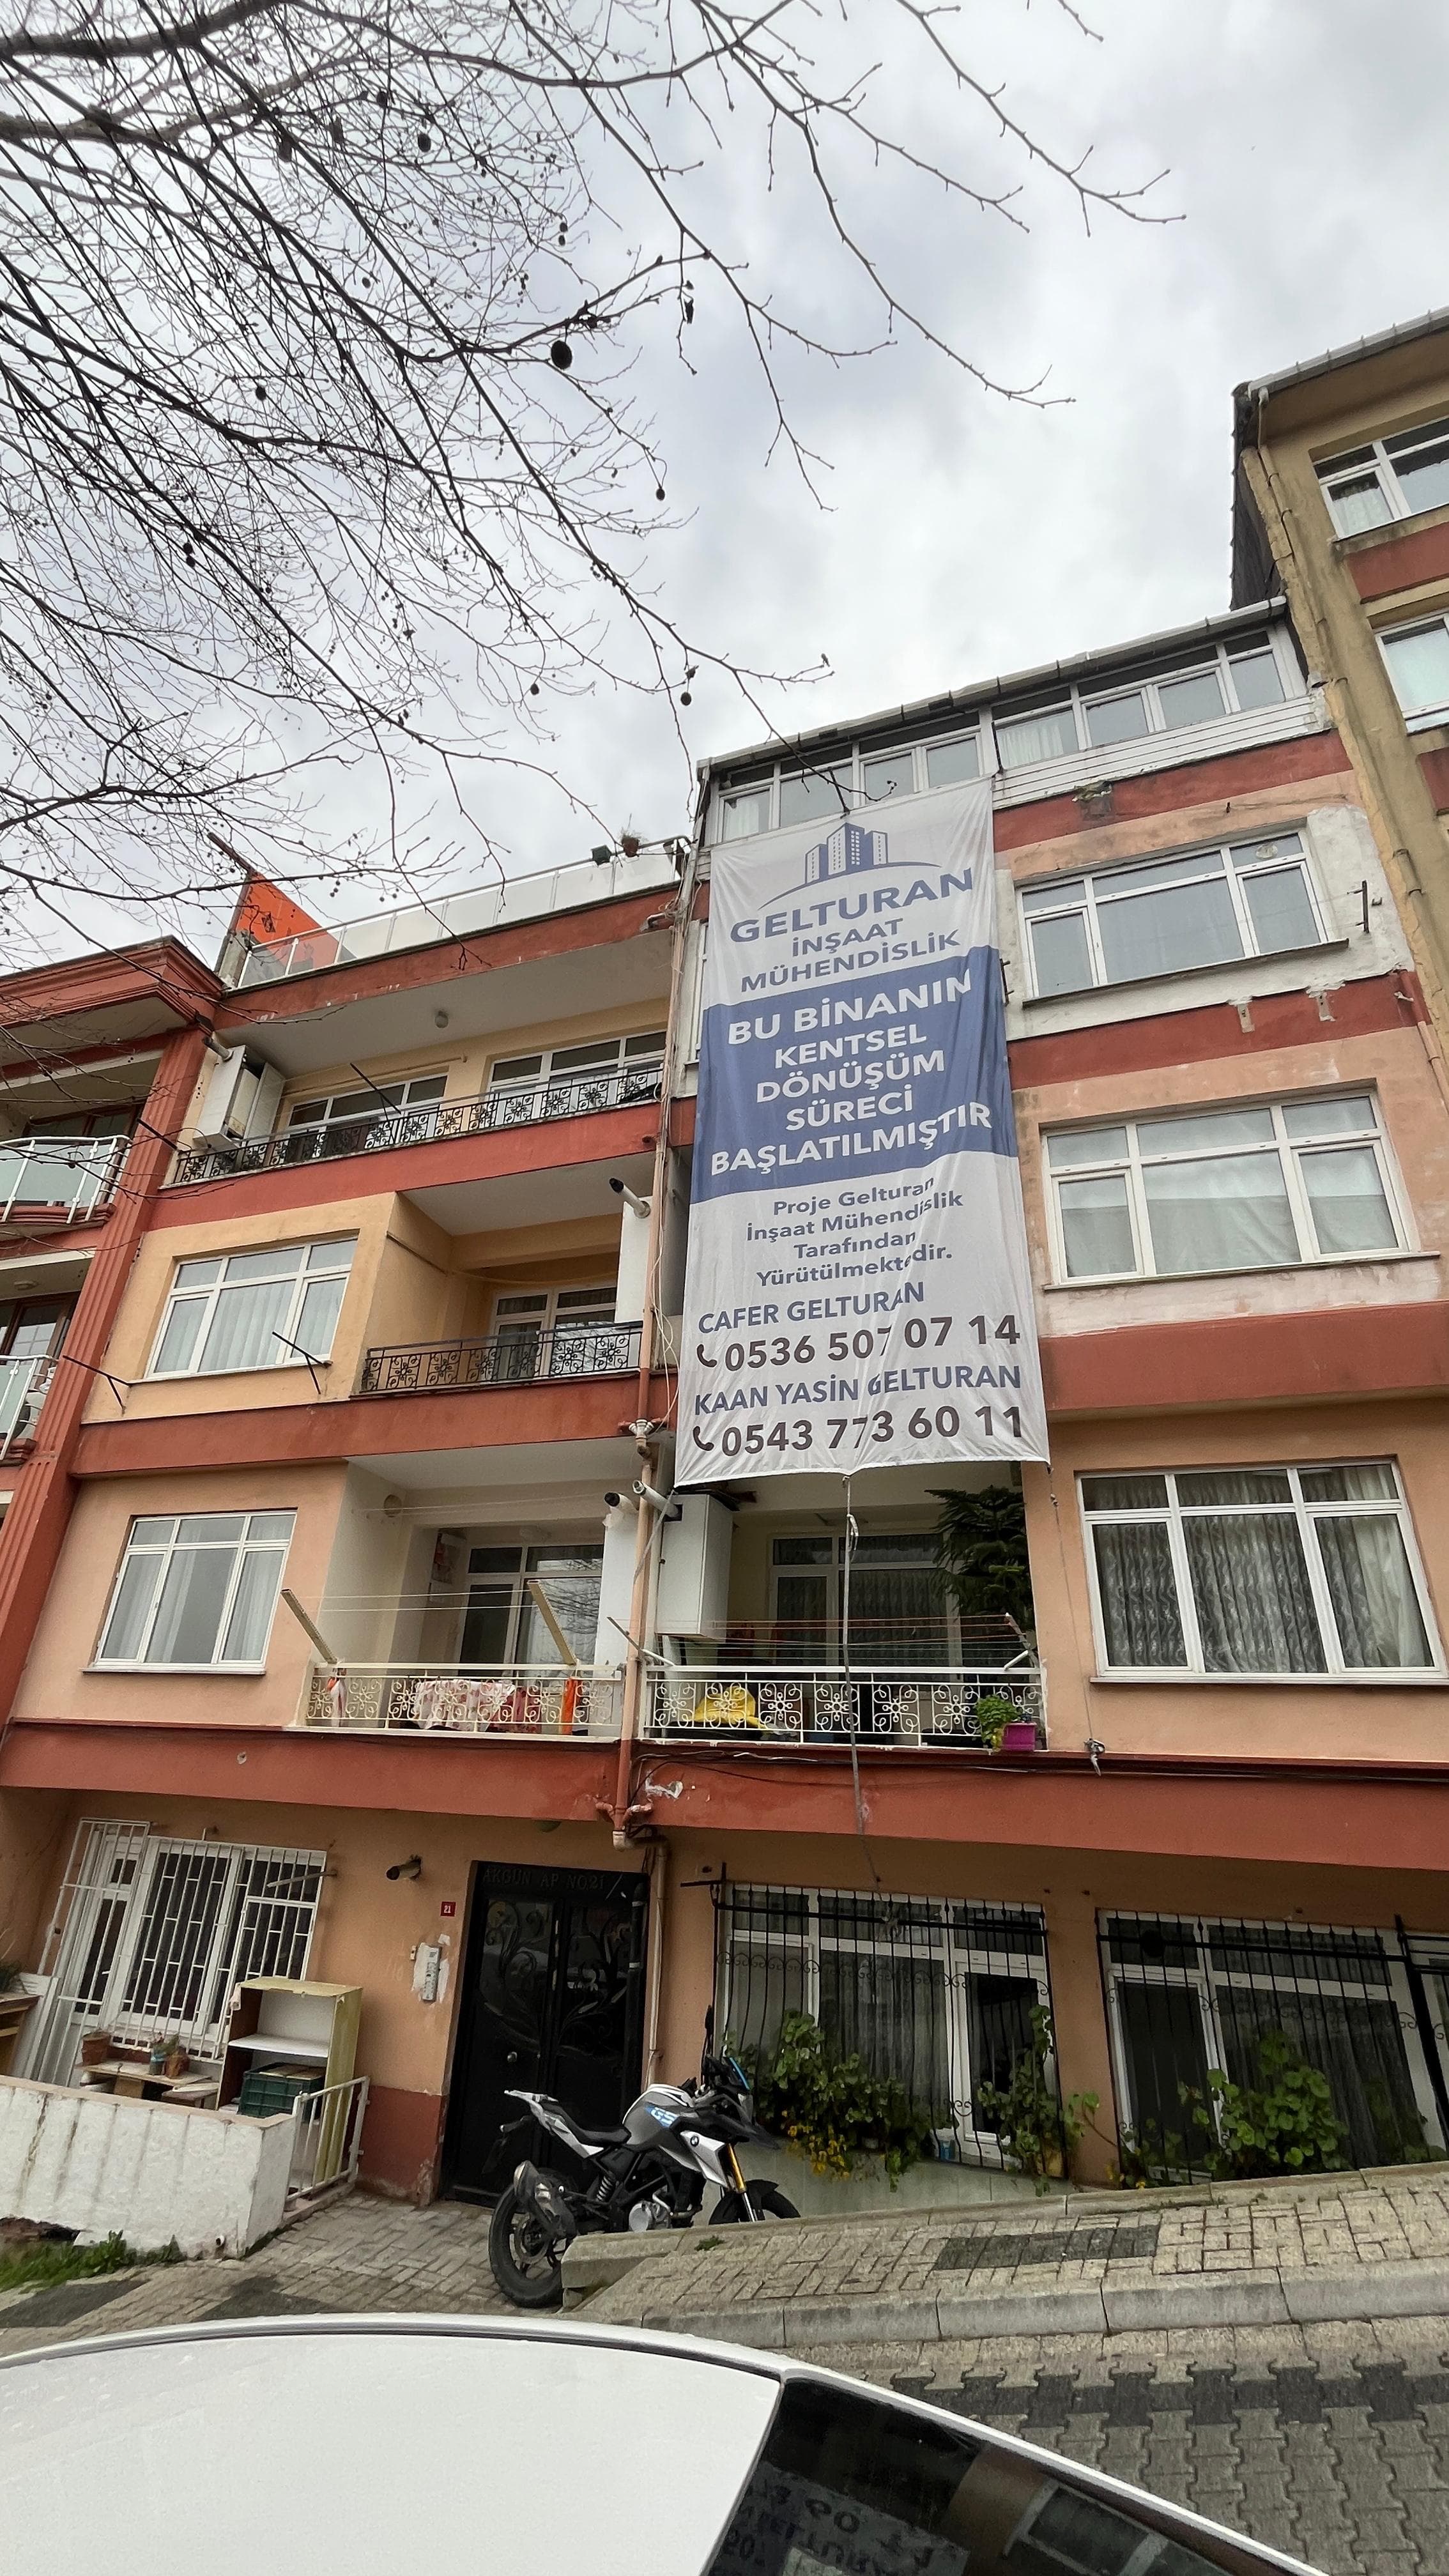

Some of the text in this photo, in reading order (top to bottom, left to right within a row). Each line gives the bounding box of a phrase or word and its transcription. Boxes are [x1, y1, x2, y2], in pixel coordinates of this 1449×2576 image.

[730, 867, 972, 943] GELTURAN
[740, 929, 961, 993] MÜHENDİSLİK
[792, 918, 903, 957] İNŞAAT
[728, 969, 971, 1045] BU BİNANIN
[775, 1023, 927, 1069] KENTSEL
[756, 1050, 944, 1103] DÖNÜŞÜM
[785, 1084, 913, 1131] SÜRECİ
[711, 1101, 992, 1176] BAŞLATILMIŞTIR
[747, 1190, 963, 1244] İnşaat Mühendislik
[773, 1176, 934, 1216] Proje Gelturan
[794, 1230, 916, 1259] Tarafından
[698, 1281, 924, 1334] CAFER GELTURAN
[725, 1335, 815, 1372] 0536
[904, 1316, 953, 1349] 07
[969, 1314, 1020, 1345] 14
[695, 1365, 1021, 1415] KAAN YASİN GELTURAN
[722, 1405, 1022, 1456] 0543 773 60 11
[443, 1905, 451, 1913] 21
